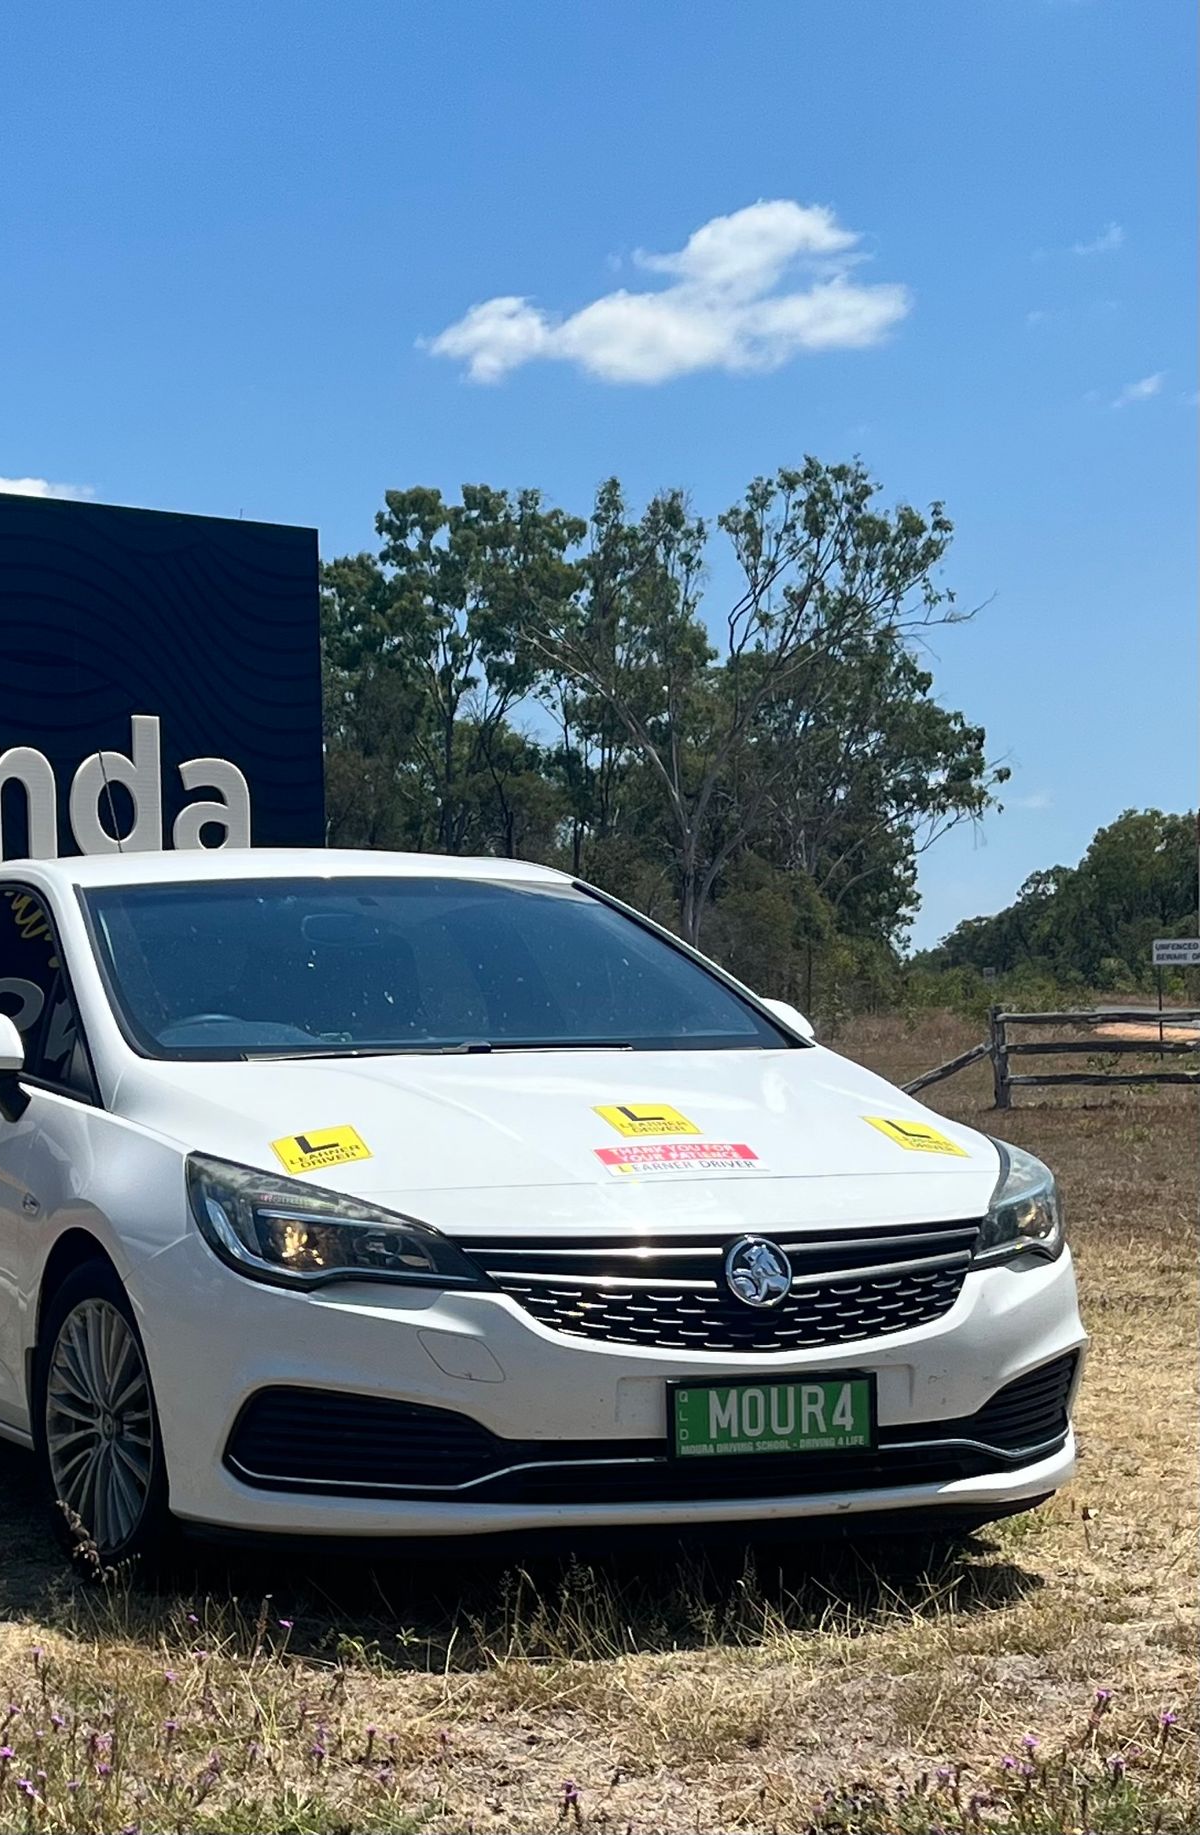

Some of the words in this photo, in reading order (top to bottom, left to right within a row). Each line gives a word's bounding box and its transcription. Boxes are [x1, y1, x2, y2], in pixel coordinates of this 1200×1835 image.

[617, 1107, 665, 1121] L
[883, 1120, 931, 1138] L
[294, 1135, 339, 1154] L
[609, 1144, 665, 1155] THANK
[666, 1144, 700, 1153] YOU
[702, 1143, 737, 1153] FOR
[289, 1144, 360, 1165] LEARNER
[300, 1152, 356, 1168] DRIVER
[618, 1151, 666, 1162] YOUR
[668, 1151, 742, 1161] PATIENCE
[617, 1159, 695, 1173] LEARNER
[699, 1159, 758, 1169] DRIVER
[708, 1383, 854, 1439] MOUR4
[755, 1440, 790, 1451] SCHOOL
[800, 1437, 835, 1448] DRIVING
[837, 1437, 844, 1446] 4
[846, 1435, 865, 1446] LIFE
